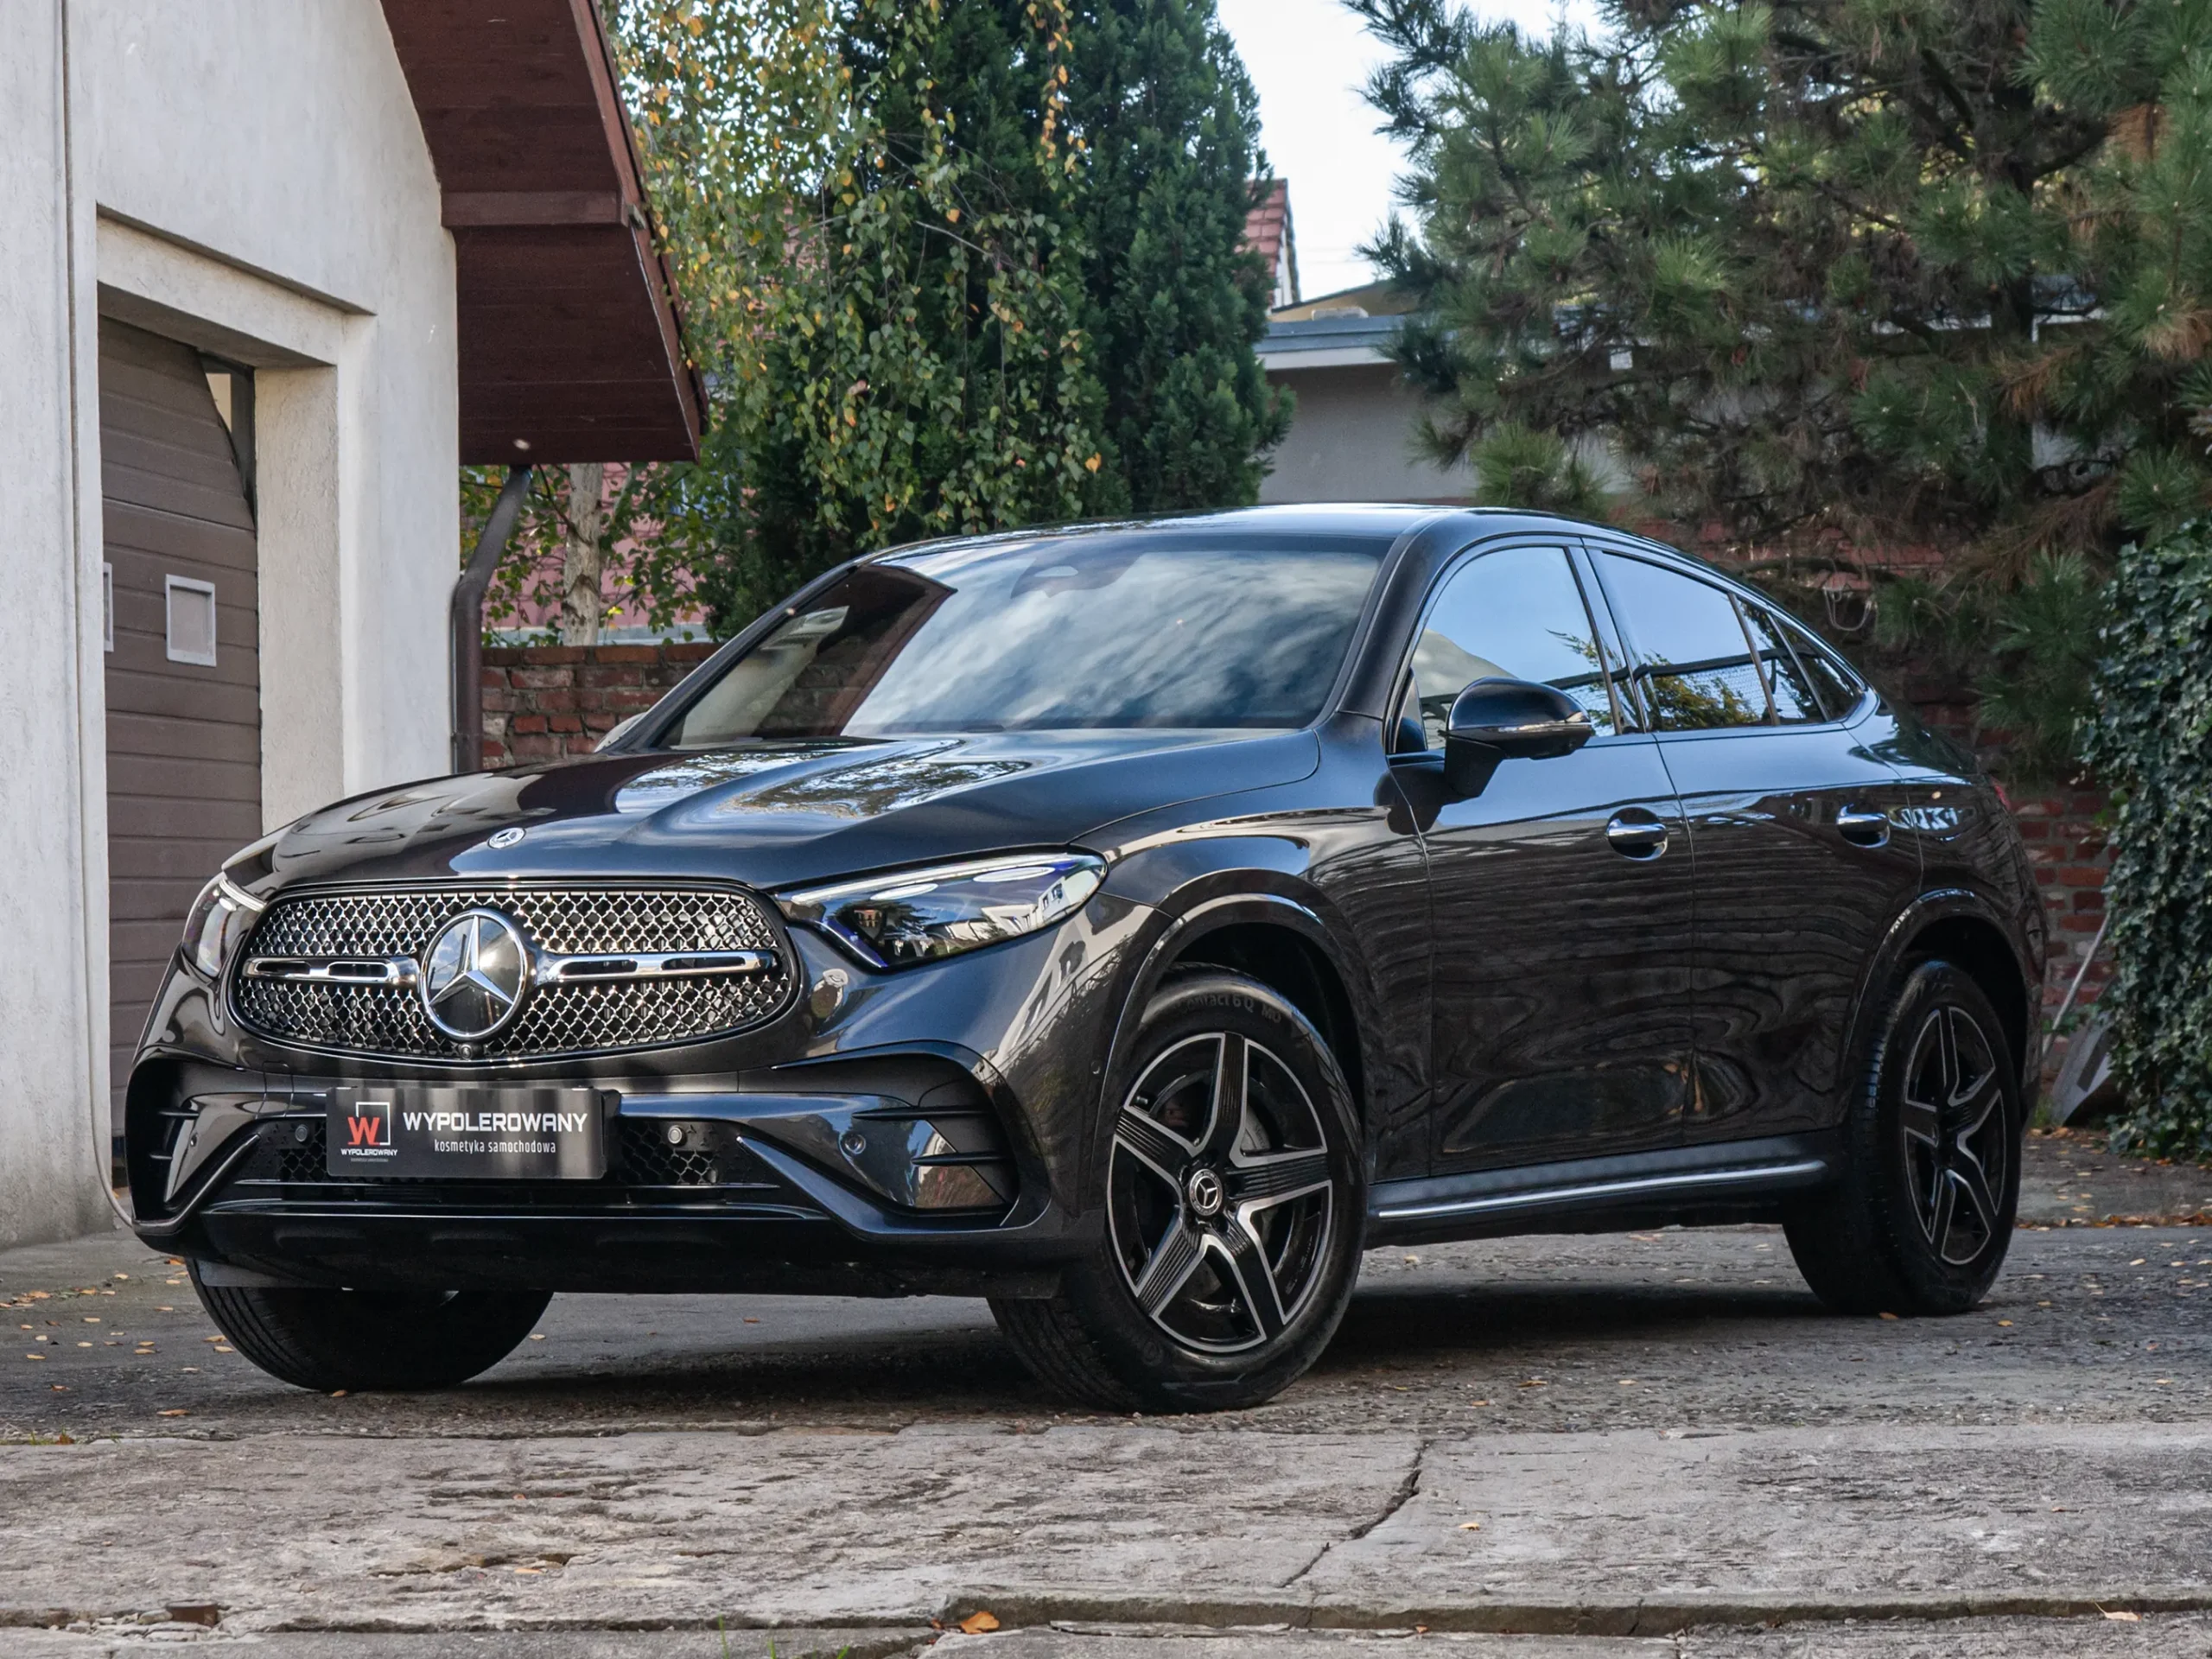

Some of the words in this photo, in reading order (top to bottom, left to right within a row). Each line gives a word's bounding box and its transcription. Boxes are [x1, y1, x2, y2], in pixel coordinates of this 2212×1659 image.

[347, 1116, 380, 1146] W
[403, 1112, 588, 1132] WYPOLEROWANY
[434, 1139, 485, 1154] kosmetyka
[488, 1140, 556, 1153] samochodowa
